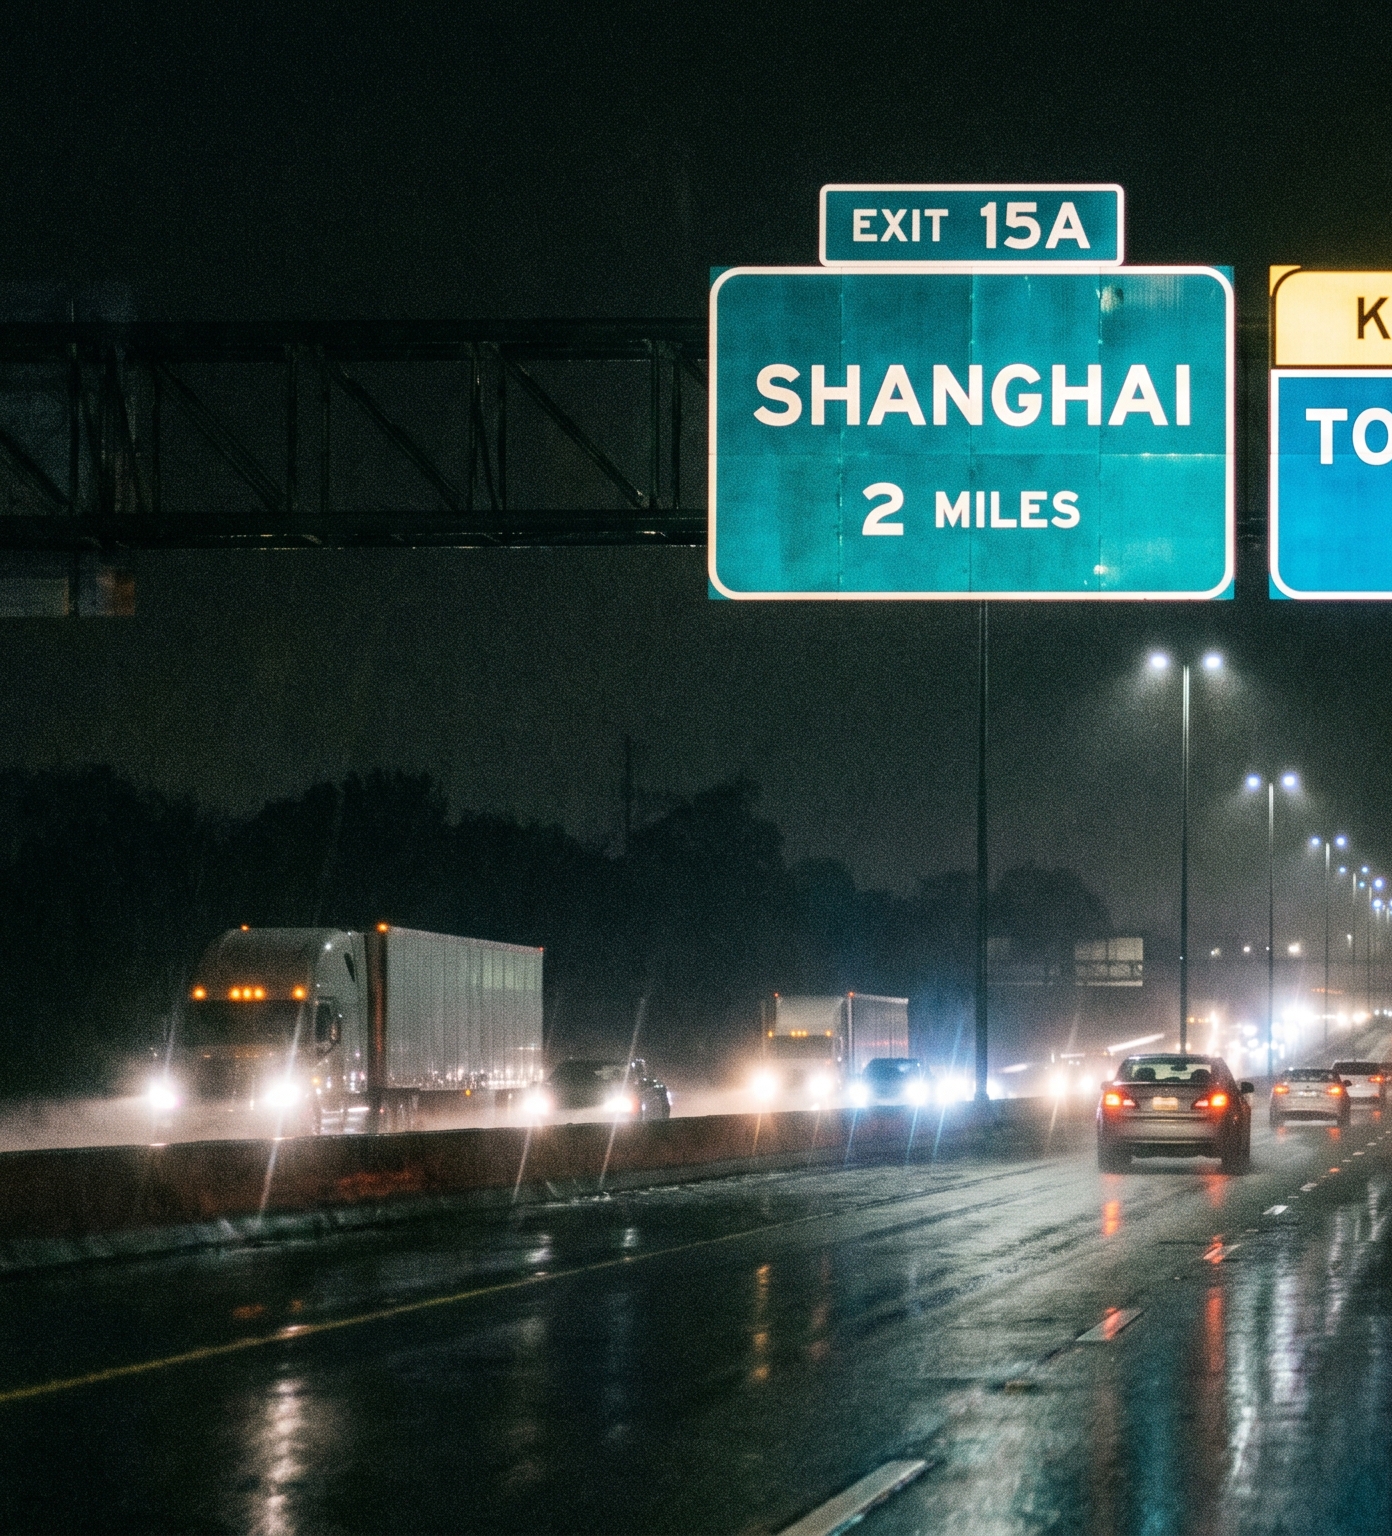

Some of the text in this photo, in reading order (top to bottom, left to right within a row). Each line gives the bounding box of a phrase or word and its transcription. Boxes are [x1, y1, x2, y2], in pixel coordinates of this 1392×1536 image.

[853, 202, 1090, 249] EXIT 15A
[754, 364, 1190, 427] SHANGHAI
[862, 483, 1080, 535] 2 MILES
